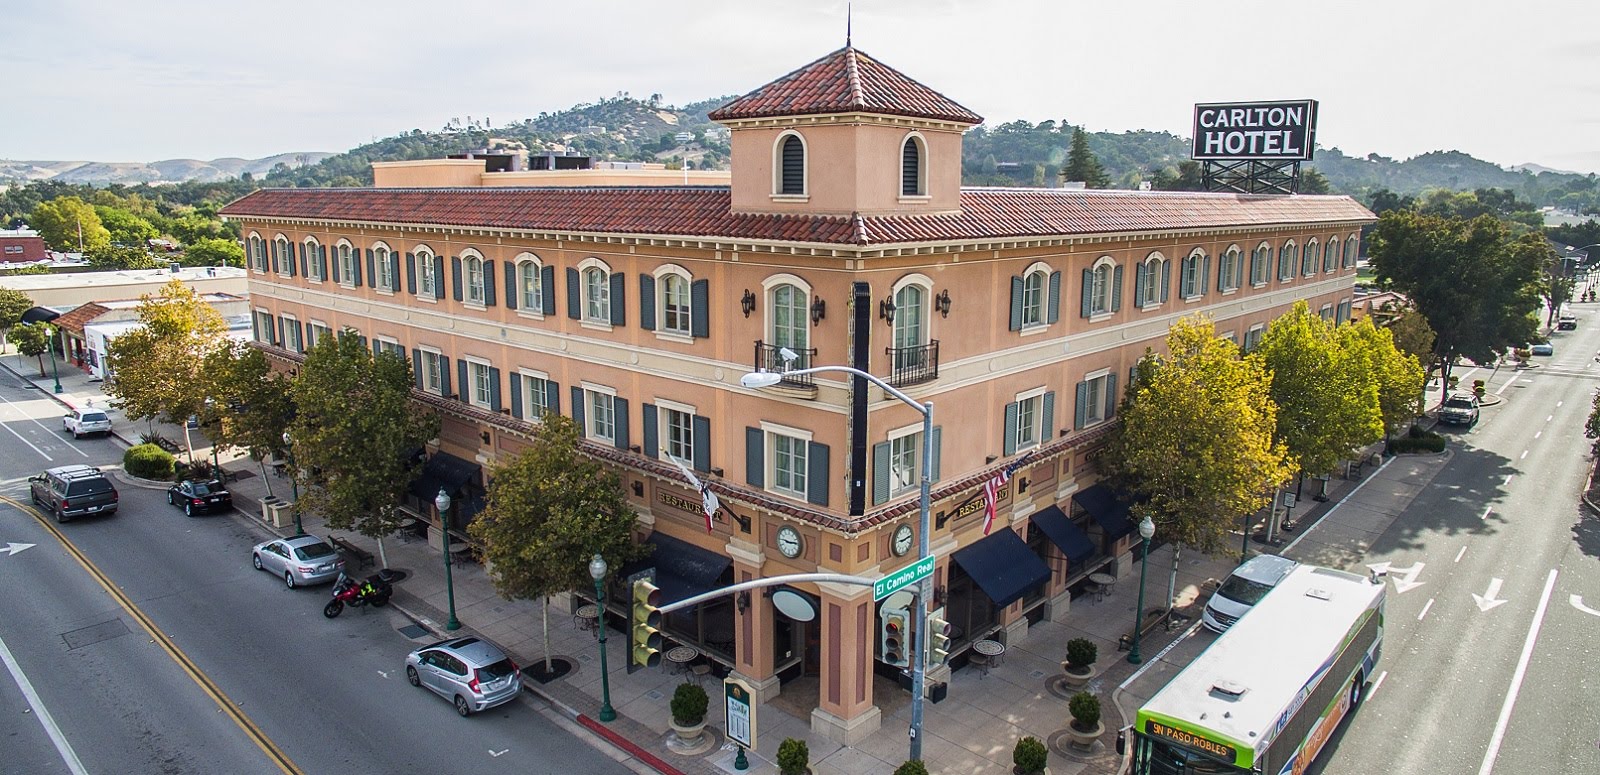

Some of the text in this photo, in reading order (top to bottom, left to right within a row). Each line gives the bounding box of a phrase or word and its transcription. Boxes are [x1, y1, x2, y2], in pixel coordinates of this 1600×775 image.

[1200, 107, 1302, 128] CARLTON
[1204, 130, 1299, 154] HOTEL
[659, 493, 721, 520] RESTAURT
[876, 583, 884, 596] El
[886, 571, 915, 590] Camino
[917, 560, 933, 577] Real
[1153, 723, 1228, 756] 9N PASO ROBLES
